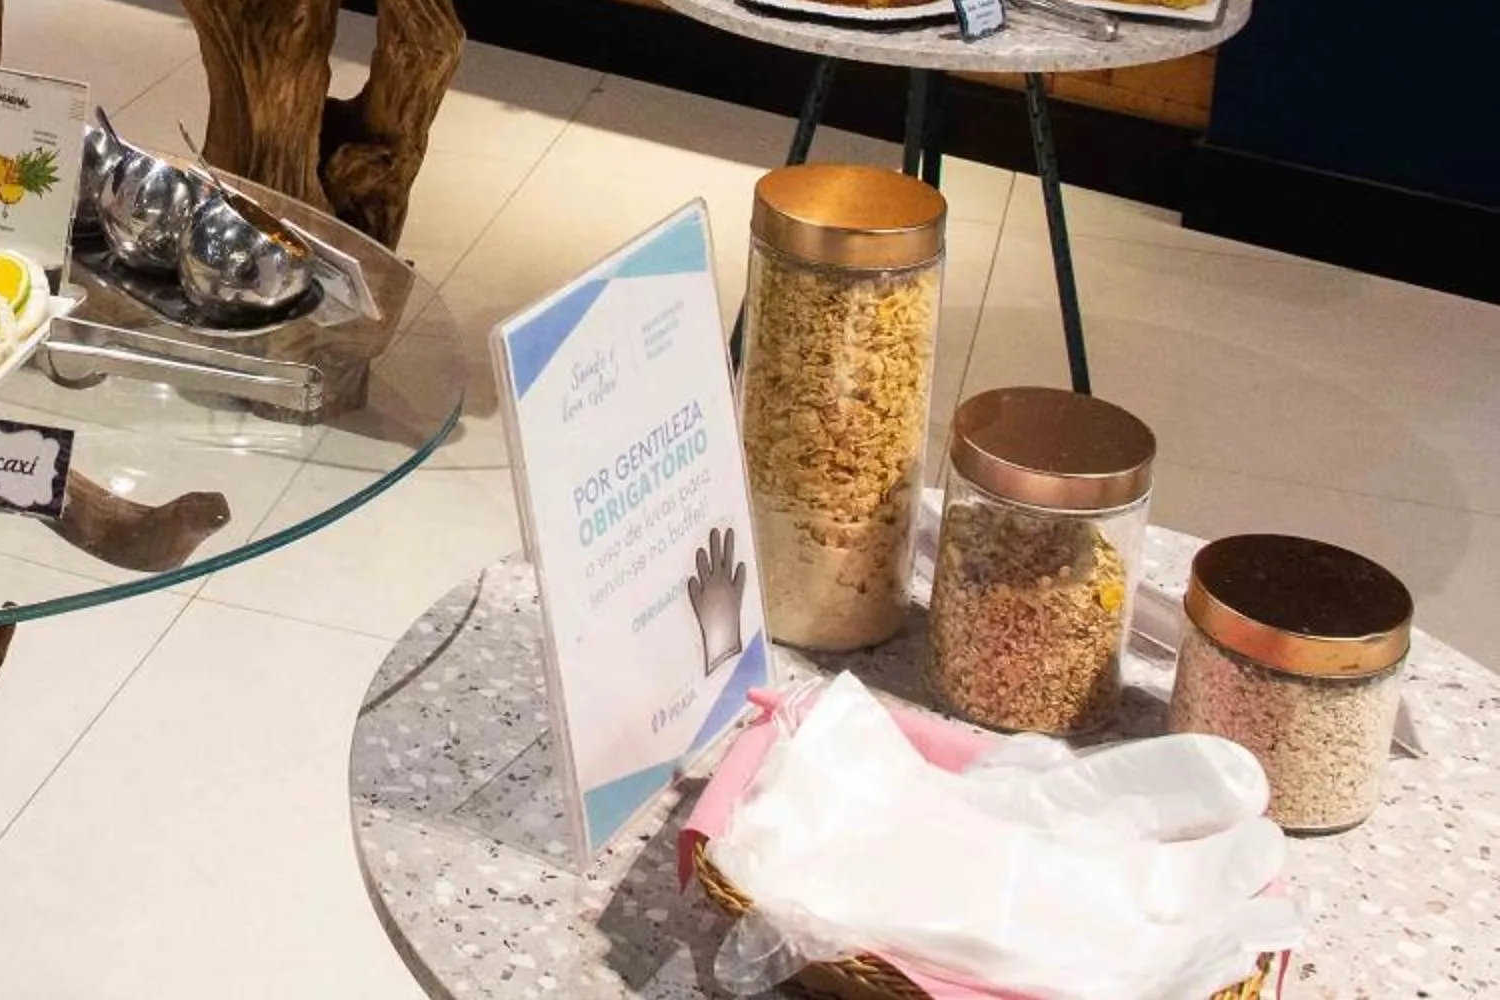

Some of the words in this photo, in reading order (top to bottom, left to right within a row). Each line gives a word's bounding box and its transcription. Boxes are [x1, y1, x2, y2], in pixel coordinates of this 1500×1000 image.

[574, 468, 612, 516] POR
[615, 399, 703, 481] GENTILEZA
[579, 428, 708, 547] OBRIGATÓRIO
[597, 540, 622, 568] uso
[624, 519, 643, 547] de
[644, 493, 676, 527] luvas
[678, 468, 711, 508] para
[650, 538, 667, 557] no
